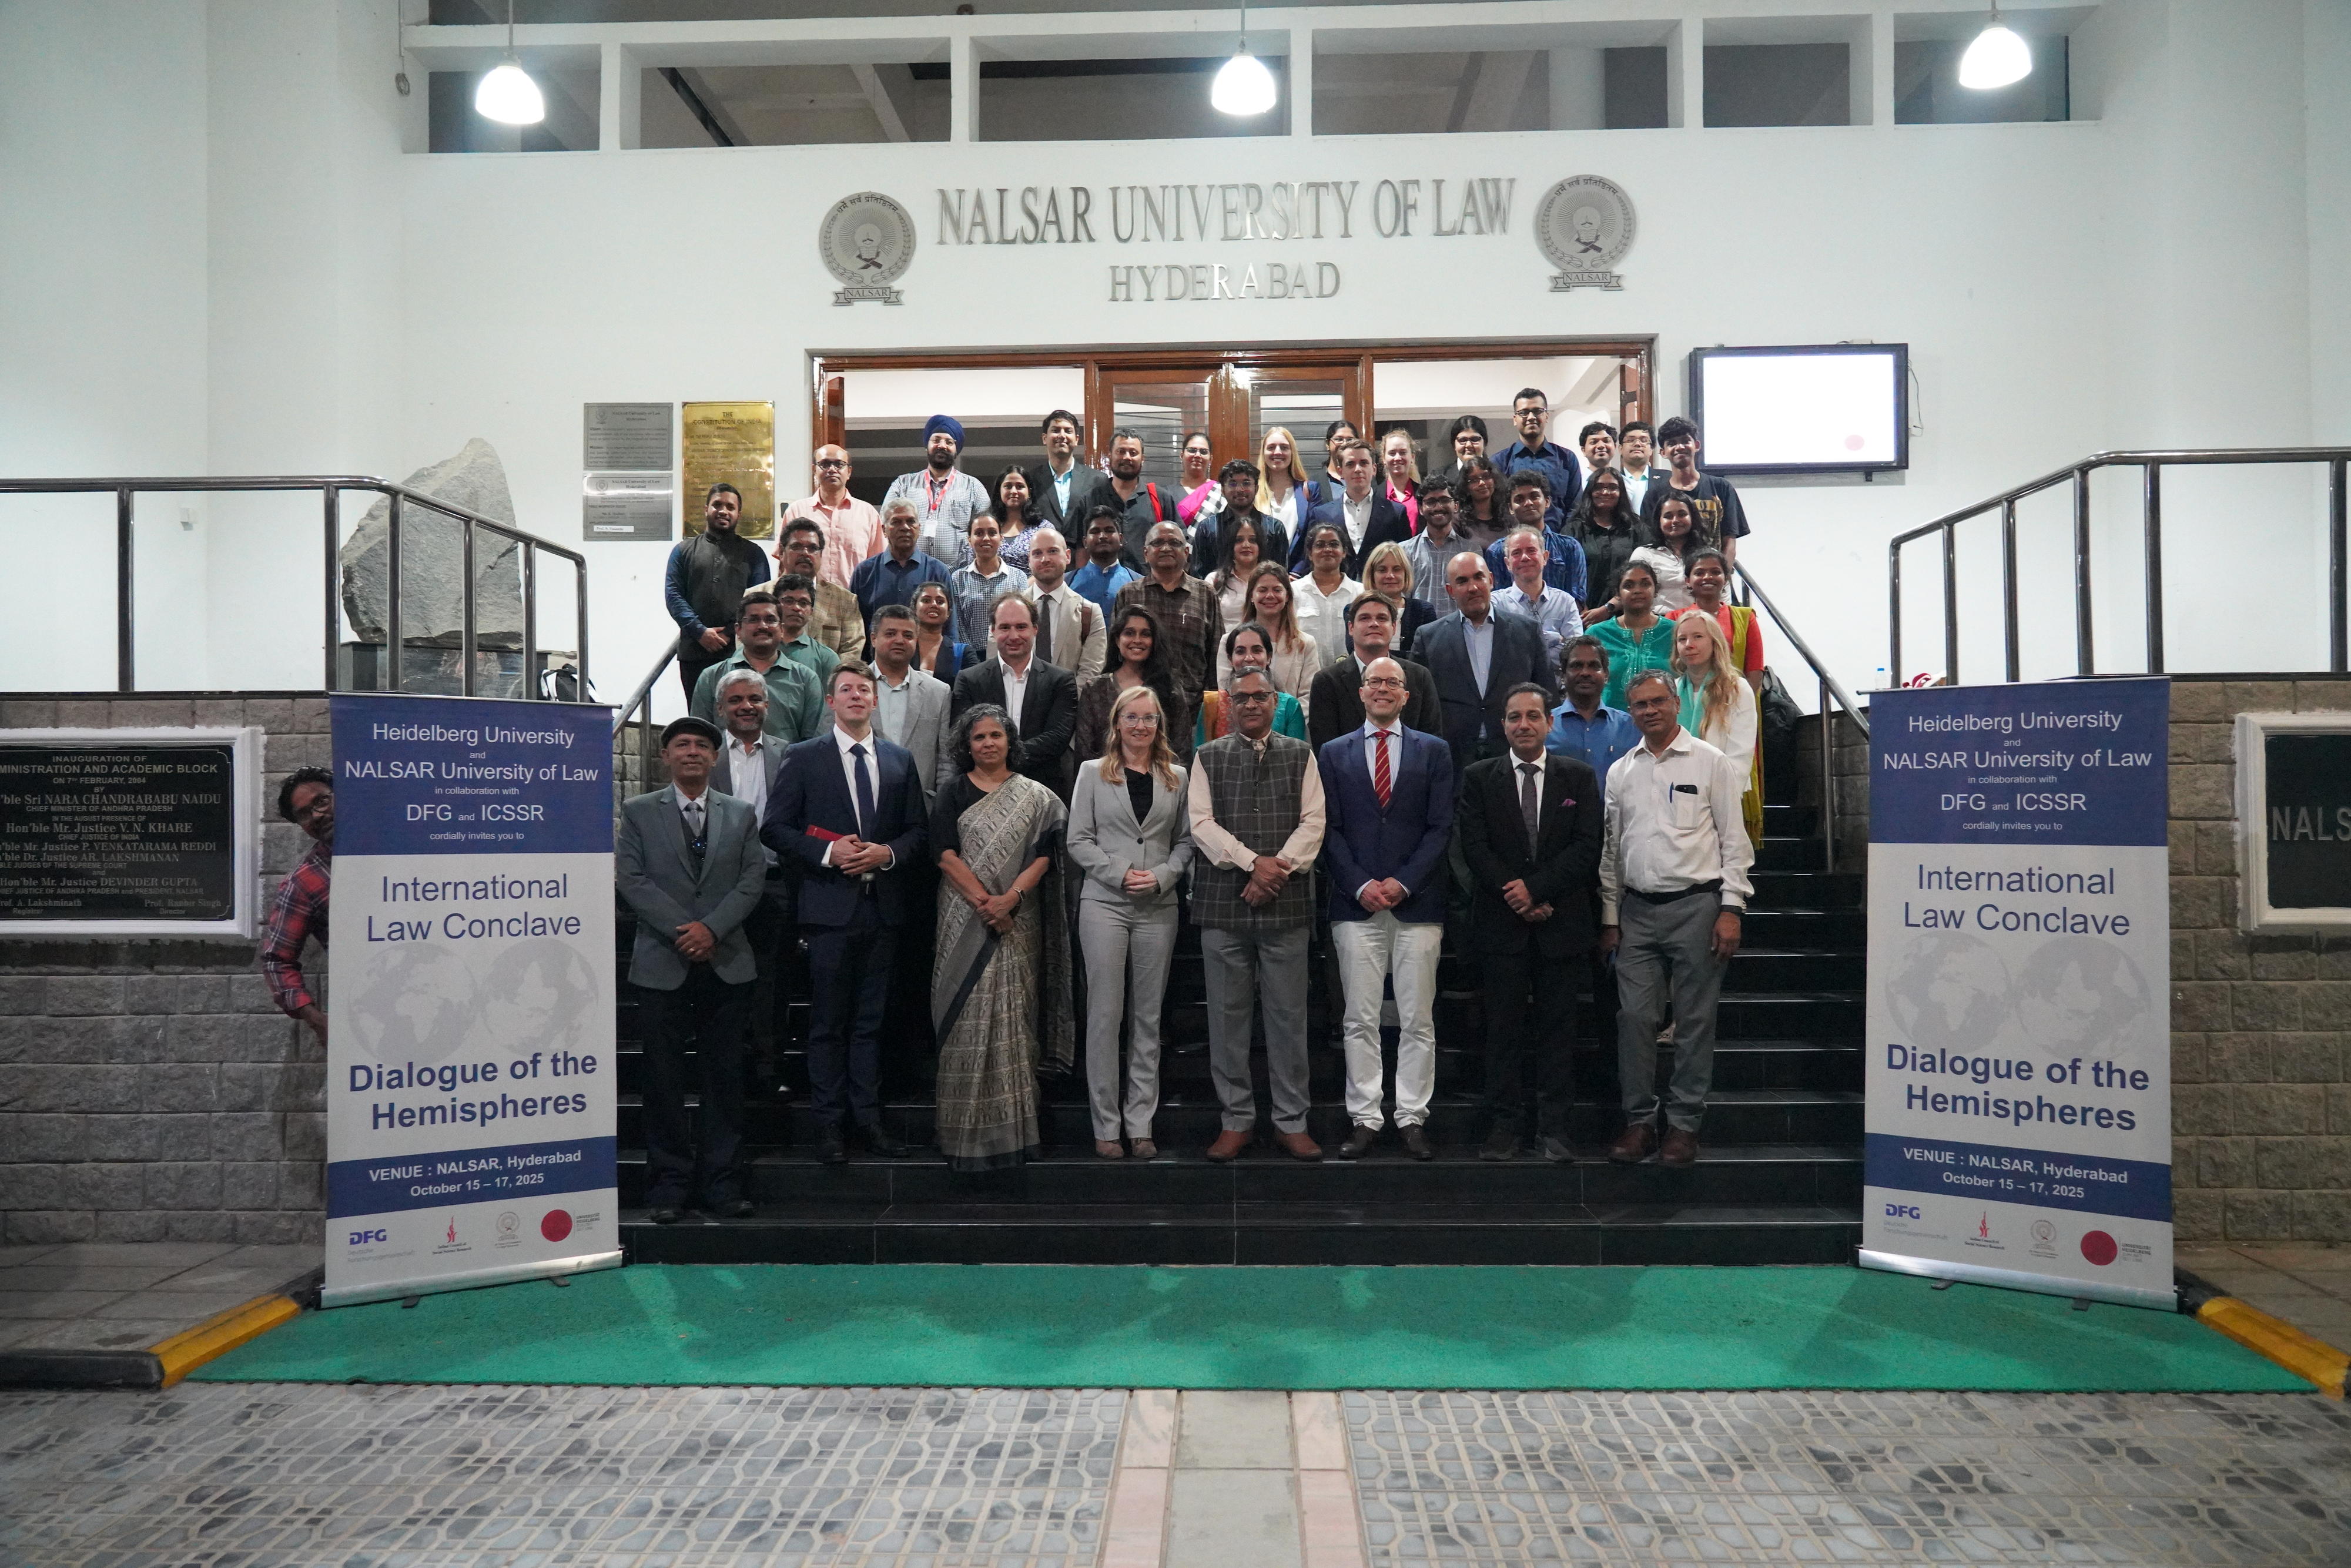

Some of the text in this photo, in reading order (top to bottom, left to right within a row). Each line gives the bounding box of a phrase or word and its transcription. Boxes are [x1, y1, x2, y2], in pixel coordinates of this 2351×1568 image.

[937, 178, 1516, 244] NALSAR UNIVERSITY OF LAW
[1108, 262, 1341, 301] HYDERABAD
[1566, 273, 1608, 282] NALSAR
[846, 289, 888, 297] NALSAR
[1909, 711, 2122, 733] Heidelberg University
[373, 723, 575, 748] Heidelberg University
[2004, 738, 2021, 746] and
[470, 751, 485, 759] and
[1884, 749, 2152, 771] NALSAR University of Law
[84, 765, 108, 773] AND
[112, 765, 173, 773] ACADEMIC
[177, 765, 218, 773] BLOCK
[346, 761, 598, 783] NALSAR University of Law
[1979, 775, 2036, 783] collaboration
[2039, 775, 2057, 783] with
[24, 795, 41, 805] Sri
[45, 795, 79, 804] NARA
[83, 795, 179, 804] CHANDRABABU
[182, 794, 222, 804] NAIDU
[446, 786, 499, 795] collaboration
[503, 787, 519, 795] with
[1941, 793, 2087, 810] DFG and ICSSR
[407, 805, 543, 821] DFG and ICSSR
[2272, 806, 2351, 841] NALS
[6, 823, 193, 833] Hon'ble Mr. Justice V. N. KHARE
[430, 832, 465, 842] cordially
[468, 832, 495, 840] invites
[1963, 822, 1999, 831] cordially
[2002, 822, 2031, 830] invites
[24, 842, 216, 851] Mr. Justice P. VENKATARAMA REDDI
[24, 853, 179, 862] Dr. Justice AR. LAKSHMANAN
[42, 878, 56, 886] Mr.
[60, 878, 97, 886] Justice
[101, 878, 158, 886] DEVINDER
[162, 878, 197, 886] GUPTA
[383, 873, 567, 902] International
[1919, 865, 2114, 894] International
[368, 912, 581, 942] Law Conclave
[1905, 902, 2130, 936] Law Conclave
[350, 1051, 597, 1092] Dialogue of the
[1887, 1044, 2149, 1090] Dialogue of the
[373, 1094, 587, 1130] Hemispheres
[1907, 1084, 2136, 1130] Hemispheres
[370, 1165, 423, 1182] VENUE
[437, 1158, 503, 1175] NALSAR,
[508, 1150, 581, 1172] Hyderabad
[1904, 1148, 1955, 1164] VENUE
[1969, 1155, 2038, 1175] NALSAR,
[2044, 1163, 2128, 1184] Hyderabad
[411, 1173, 544, 1197] October 15 17, 2025
[1943, 1171, 2085, 1198] October 15 17, 2025
[1886, 1203, 1920, 1219] DFG
[350, 1229, 386, 1245] DFG
